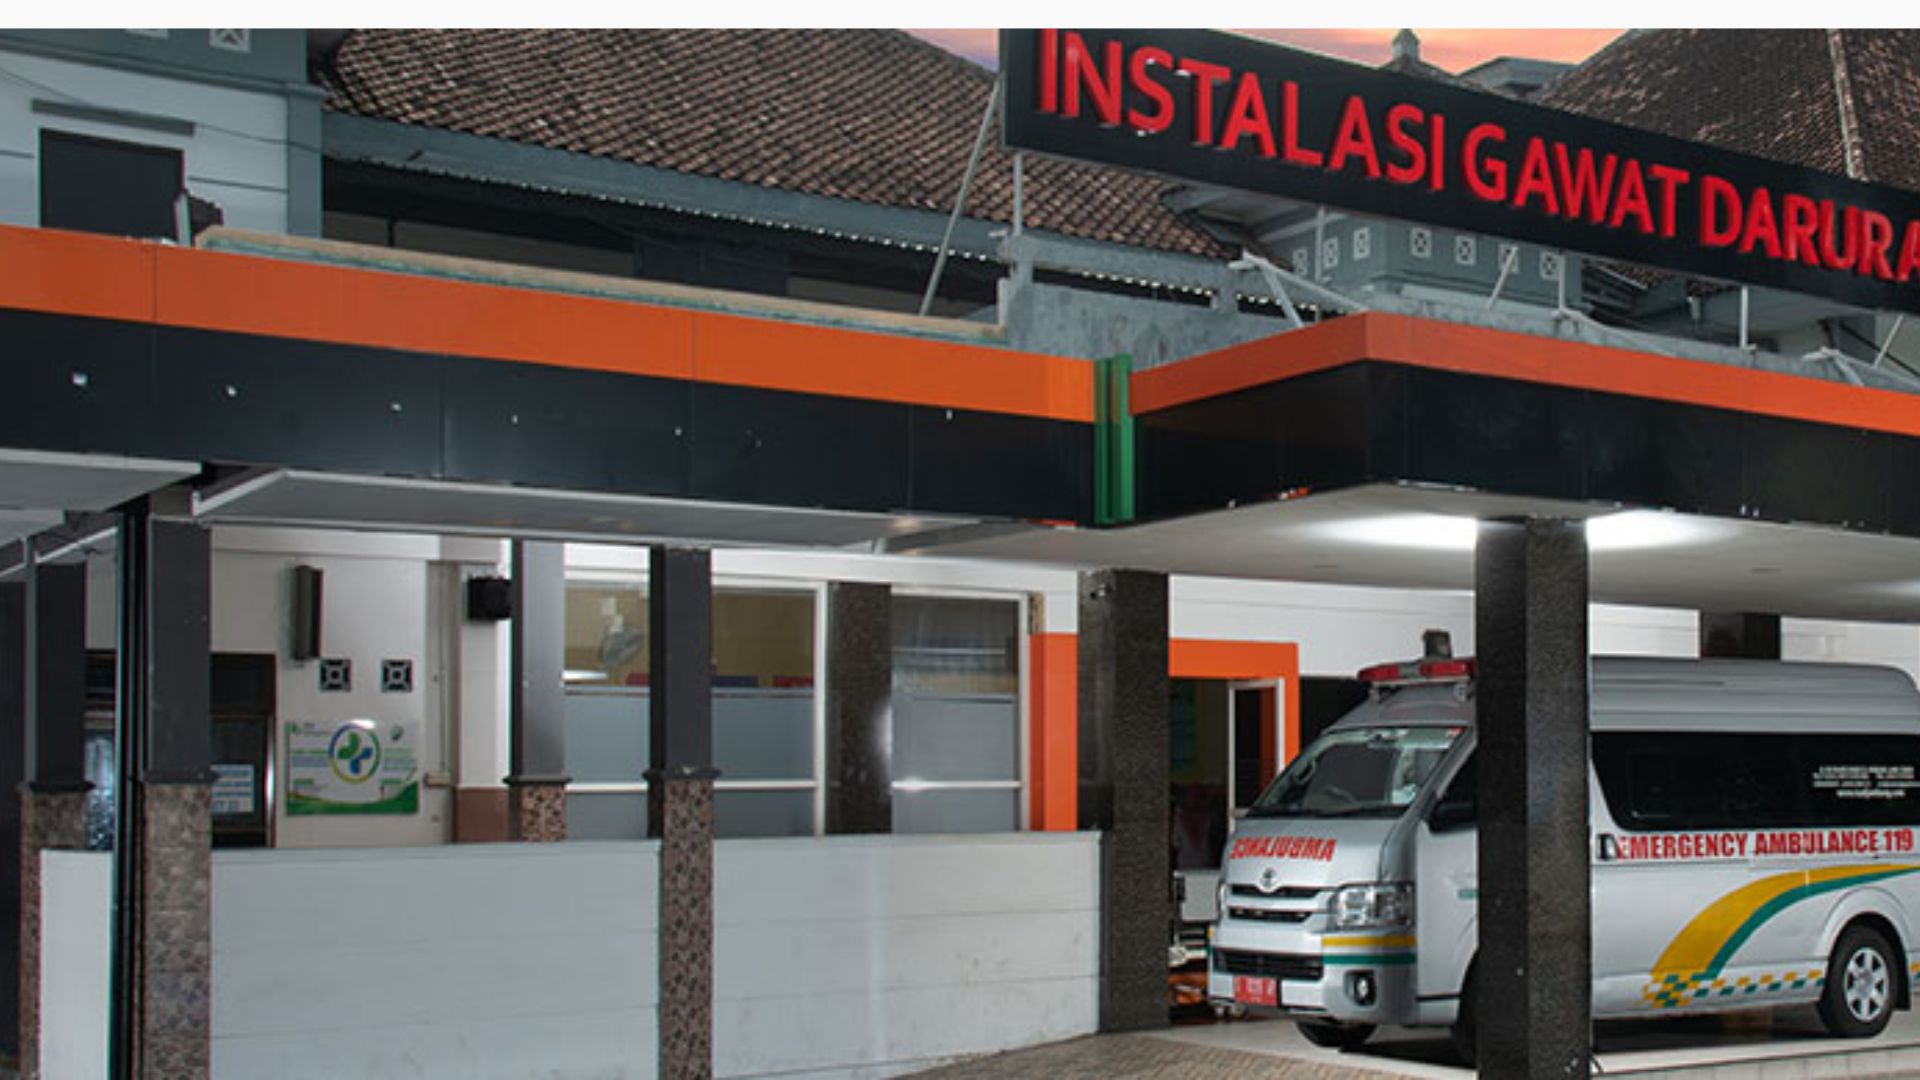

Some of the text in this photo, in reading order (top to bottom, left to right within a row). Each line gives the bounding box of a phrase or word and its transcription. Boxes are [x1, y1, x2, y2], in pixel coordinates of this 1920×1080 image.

[1039, 28, 1446, 192] INSTALASI
[1463, 122, 1690, 238] GAWAT
[1617, 828, 1914, 860] EMERGENCY AMBULANCE 119
